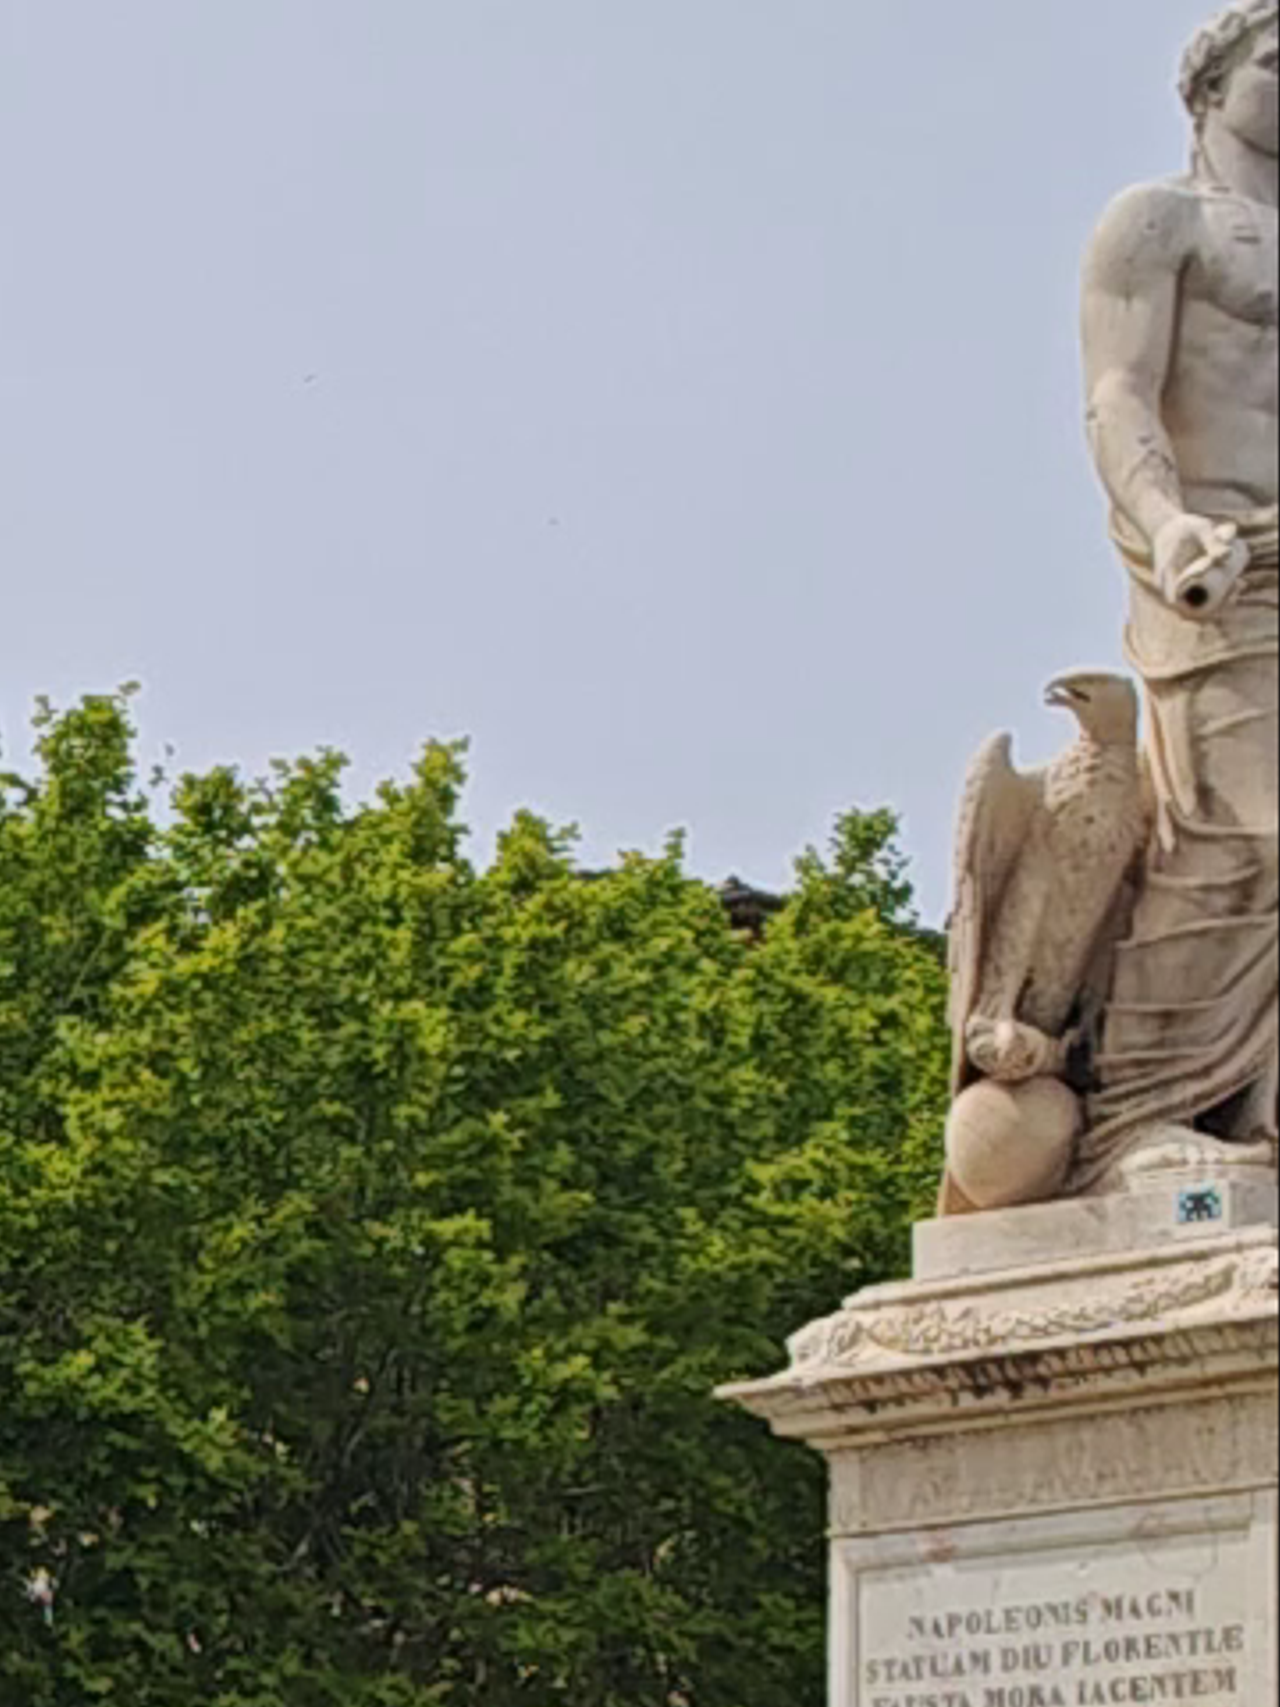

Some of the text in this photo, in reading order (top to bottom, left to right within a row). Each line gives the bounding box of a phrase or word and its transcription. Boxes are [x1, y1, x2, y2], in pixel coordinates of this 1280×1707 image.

[907, 1589, 1194, 1640] NAPOLEONIS MAGNI
[866, 1649, 991, 1685] STATUAM
[1000, 1643, 1053, 1673] DIU
[1078, 1667, 1237, 1707] IACENTEM
